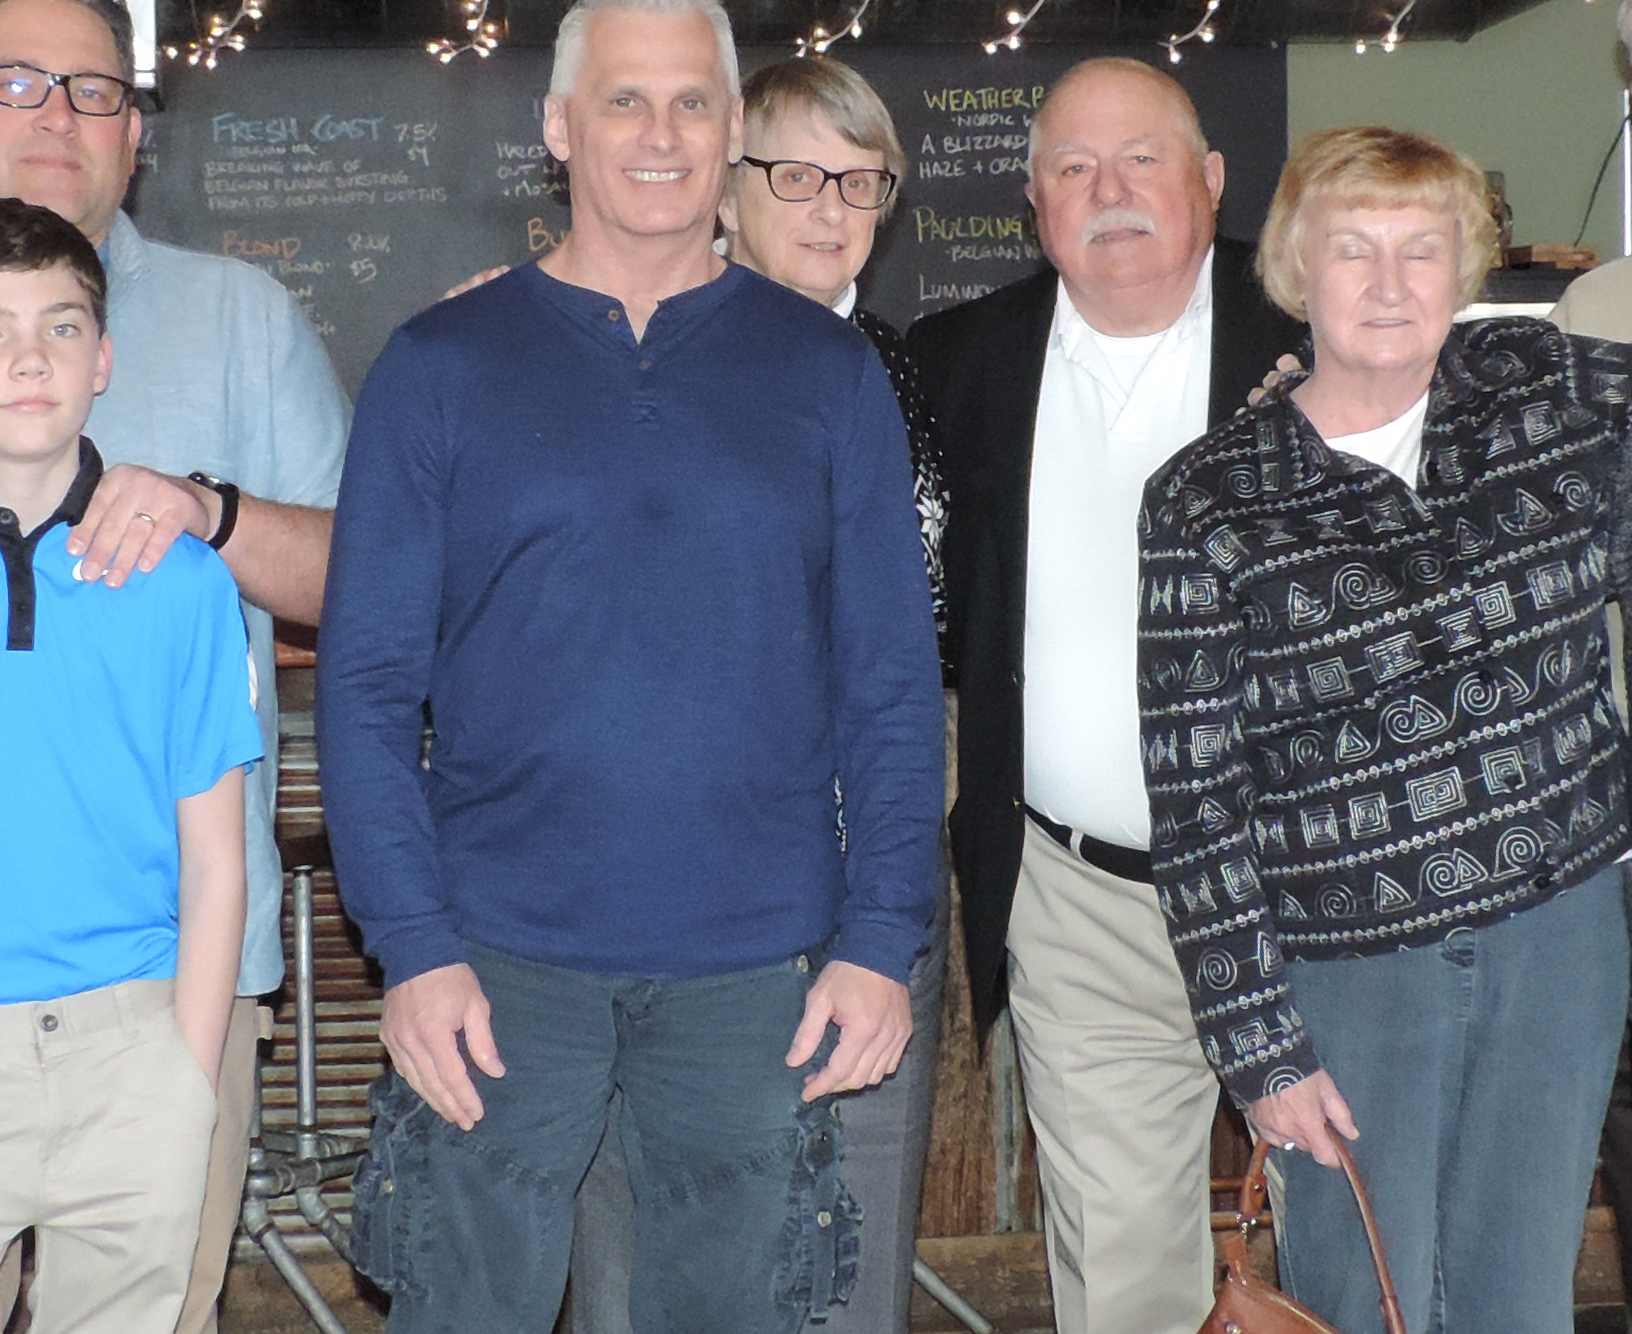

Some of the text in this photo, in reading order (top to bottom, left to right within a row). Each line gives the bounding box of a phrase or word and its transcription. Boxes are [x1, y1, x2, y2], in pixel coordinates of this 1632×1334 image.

[211, 112, 299, 143] FRESH
[311, 114, 384, 143] COAST
[920, 133, 936, 155] A
[918, 158, 967, 180] HAZE
[912, 206, 1024, 244] PAULDING
[222, 229, 303, 260] BLOND
